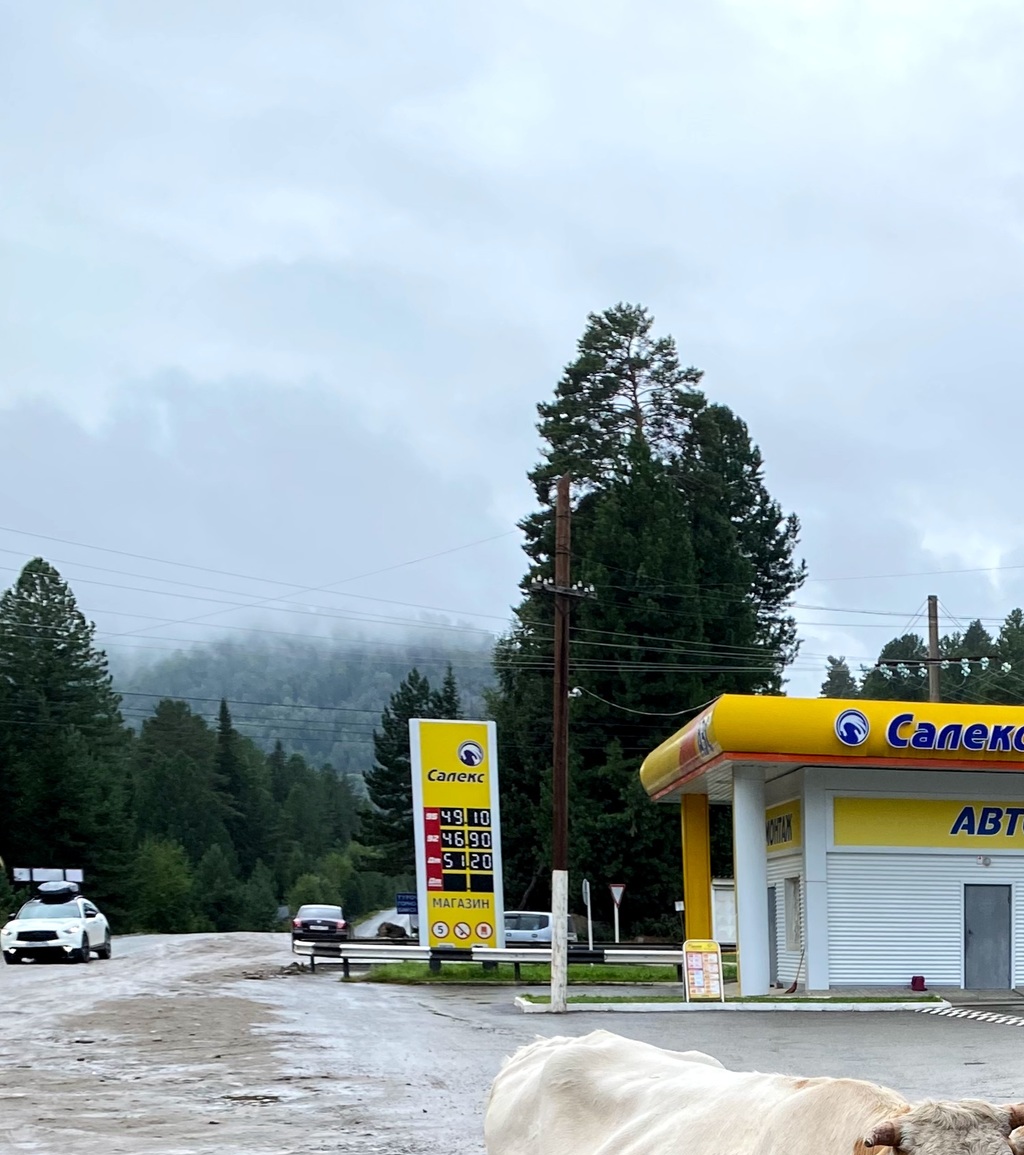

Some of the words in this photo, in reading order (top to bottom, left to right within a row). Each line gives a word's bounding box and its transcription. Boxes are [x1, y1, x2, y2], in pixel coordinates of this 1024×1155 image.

[427, 769, 485, 783] Салекс
[432, 898, 490, 909] МАГАЗИН
[437, 925, 444, 934] 5
